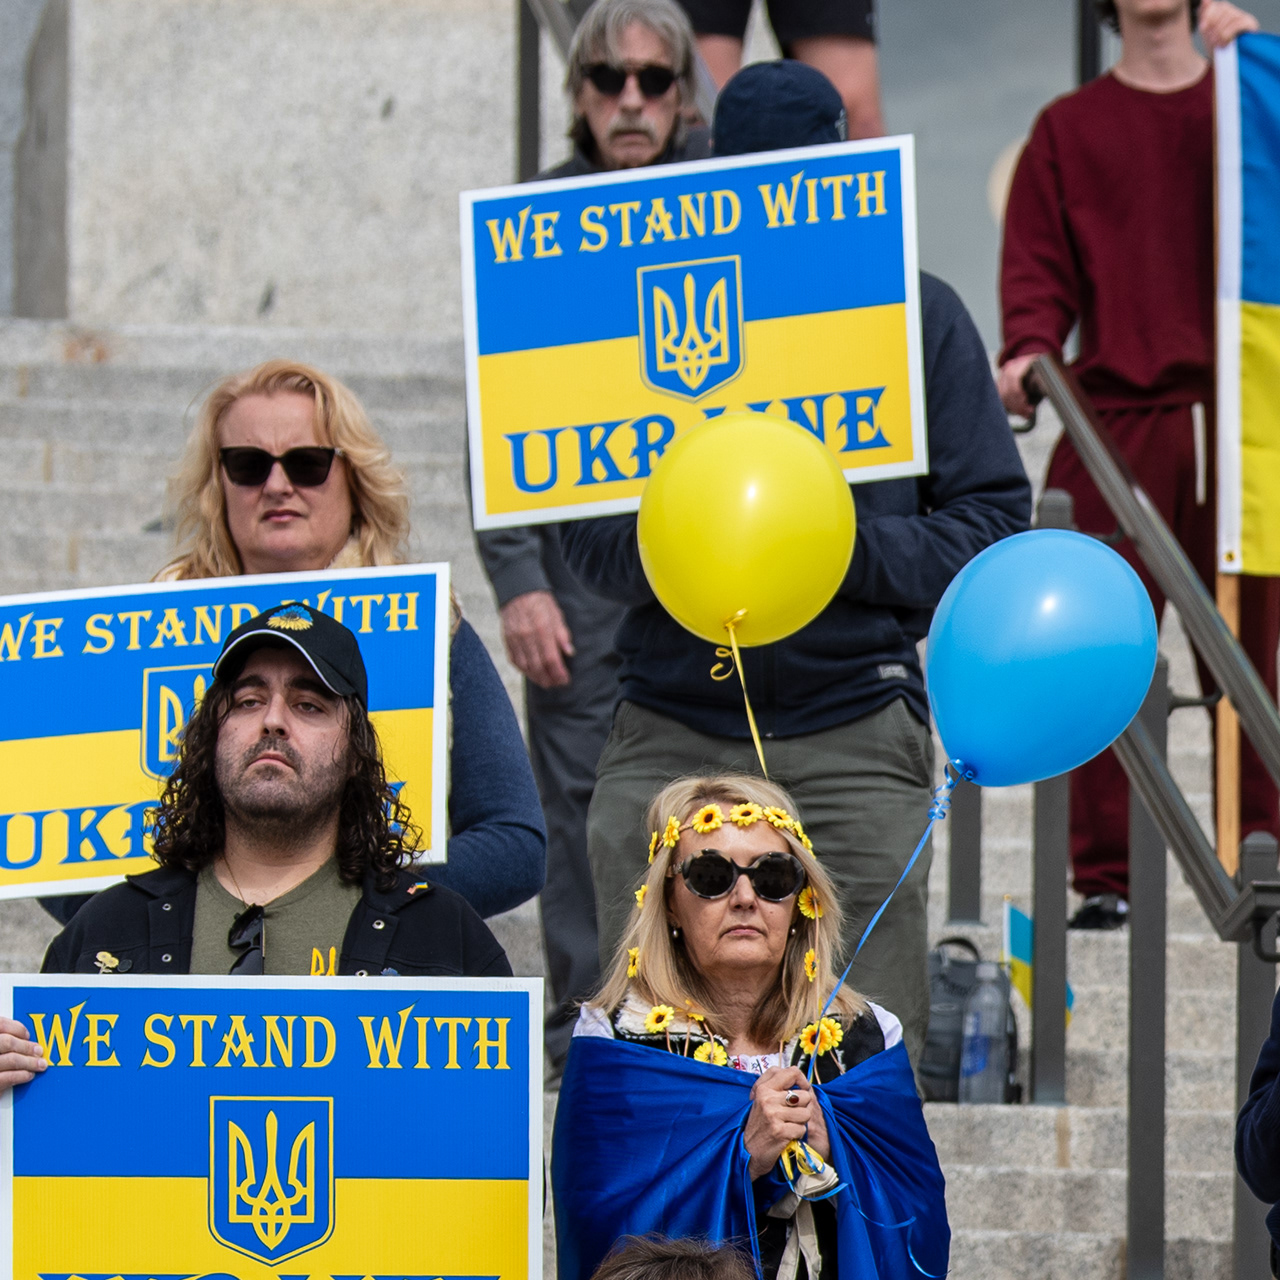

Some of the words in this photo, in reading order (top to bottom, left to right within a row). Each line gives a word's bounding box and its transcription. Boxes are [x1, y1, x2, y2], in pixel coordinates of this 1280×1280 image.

[485, 204, 563, 264] WE
[578, 189, 743, 253] STAND
[757, 169, 889, 229] WITH
[0, 612, 64, 662] WE
[281, 588, 420, 633] ITH
[28, 996, 121, 1068] WE
[138, 1012, 338, 1071] STAND
[357, 998, 512, 1071] WITH
